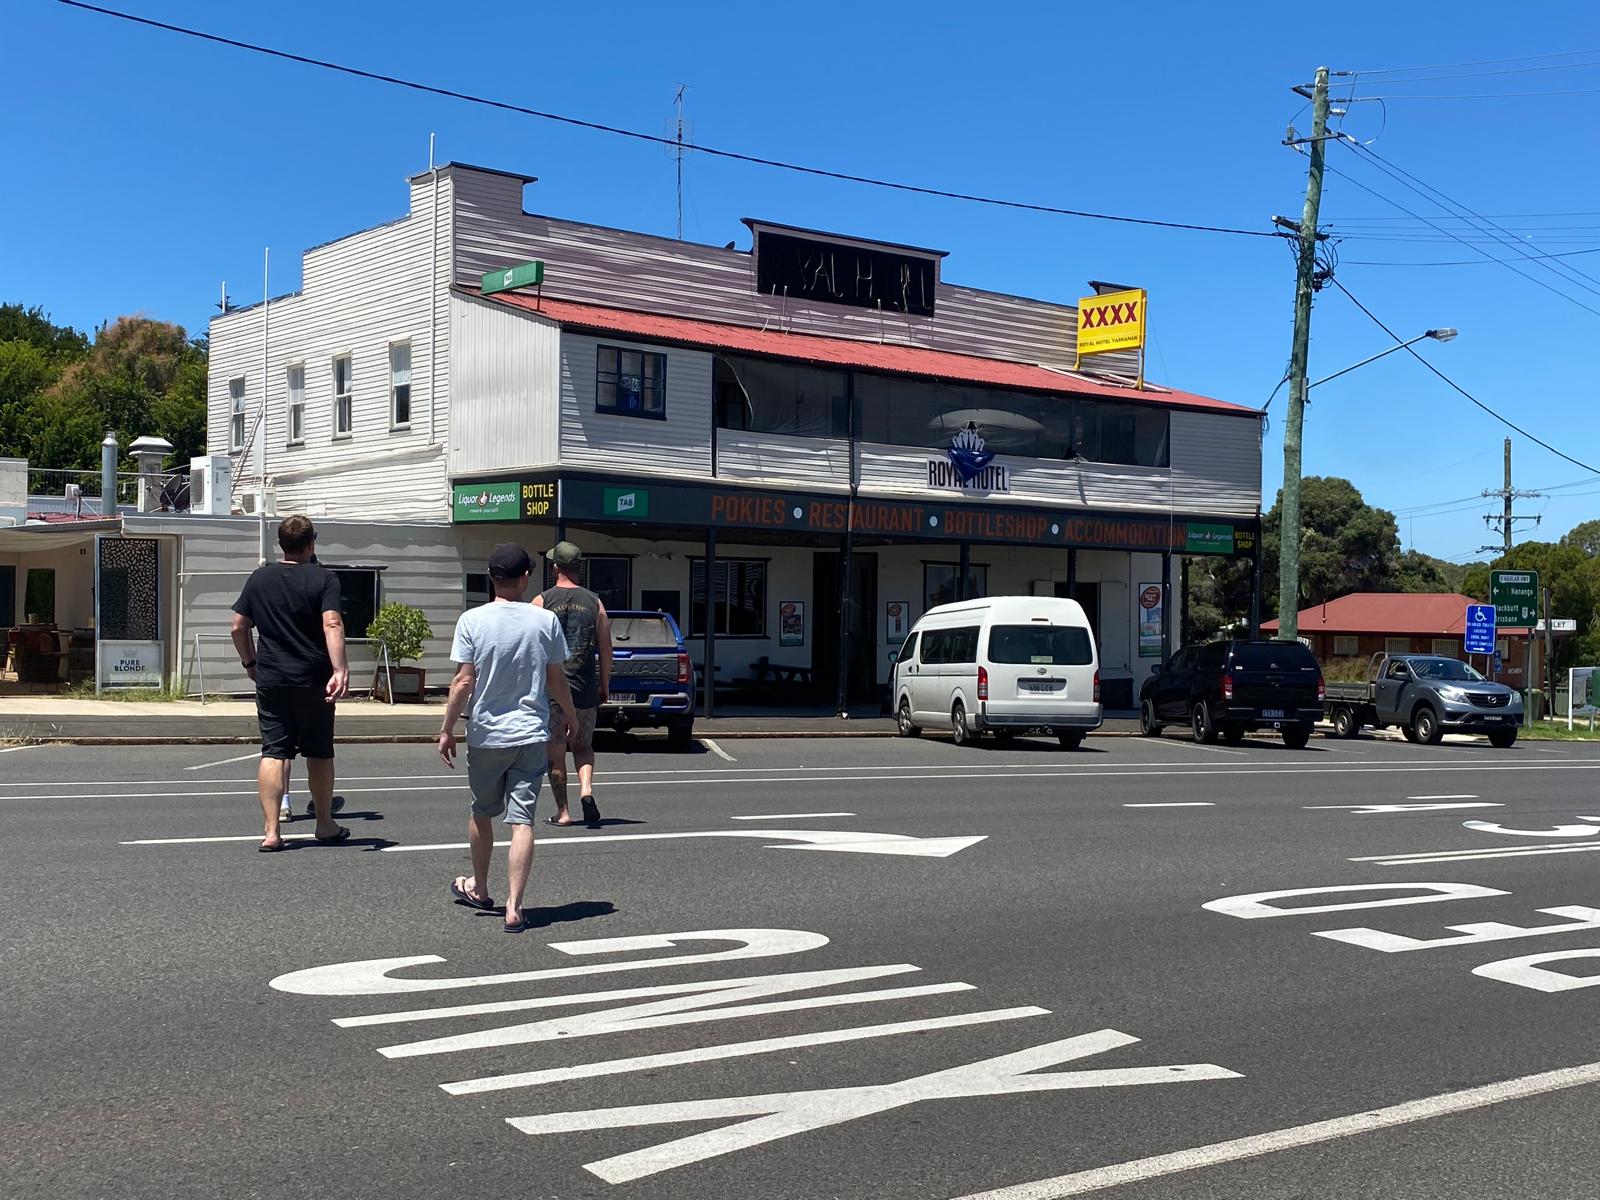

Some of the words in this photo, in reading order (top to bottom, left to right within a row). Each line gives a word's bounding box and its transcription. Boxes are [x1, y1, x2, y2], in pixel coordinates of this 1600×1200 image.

[1081, 301, 1138, 330] XXXX
[928, 461, 969, 488] ROYA
[522, 484, 554, 498] BOTTLE
[458, 493, 478, 506] Liquor
[488, 491, 516, 506] Legends
[619, 498, 633, 507] TAB
[526, 501, 549, 515] SHOP
[711, 495, 785, 525] POKIES
[808, 502, 924, 533] RESTAURANT
[944, 510, 1048, 538] BOTTLESHOP
[1064, 519, 1186, 546] ACCOMMODATION
[1234, 531, 1256, 540] BOTTLE
[1237, 540, 1253, 549] SHOP
[1511, 587, 1533, 597] Nanango
